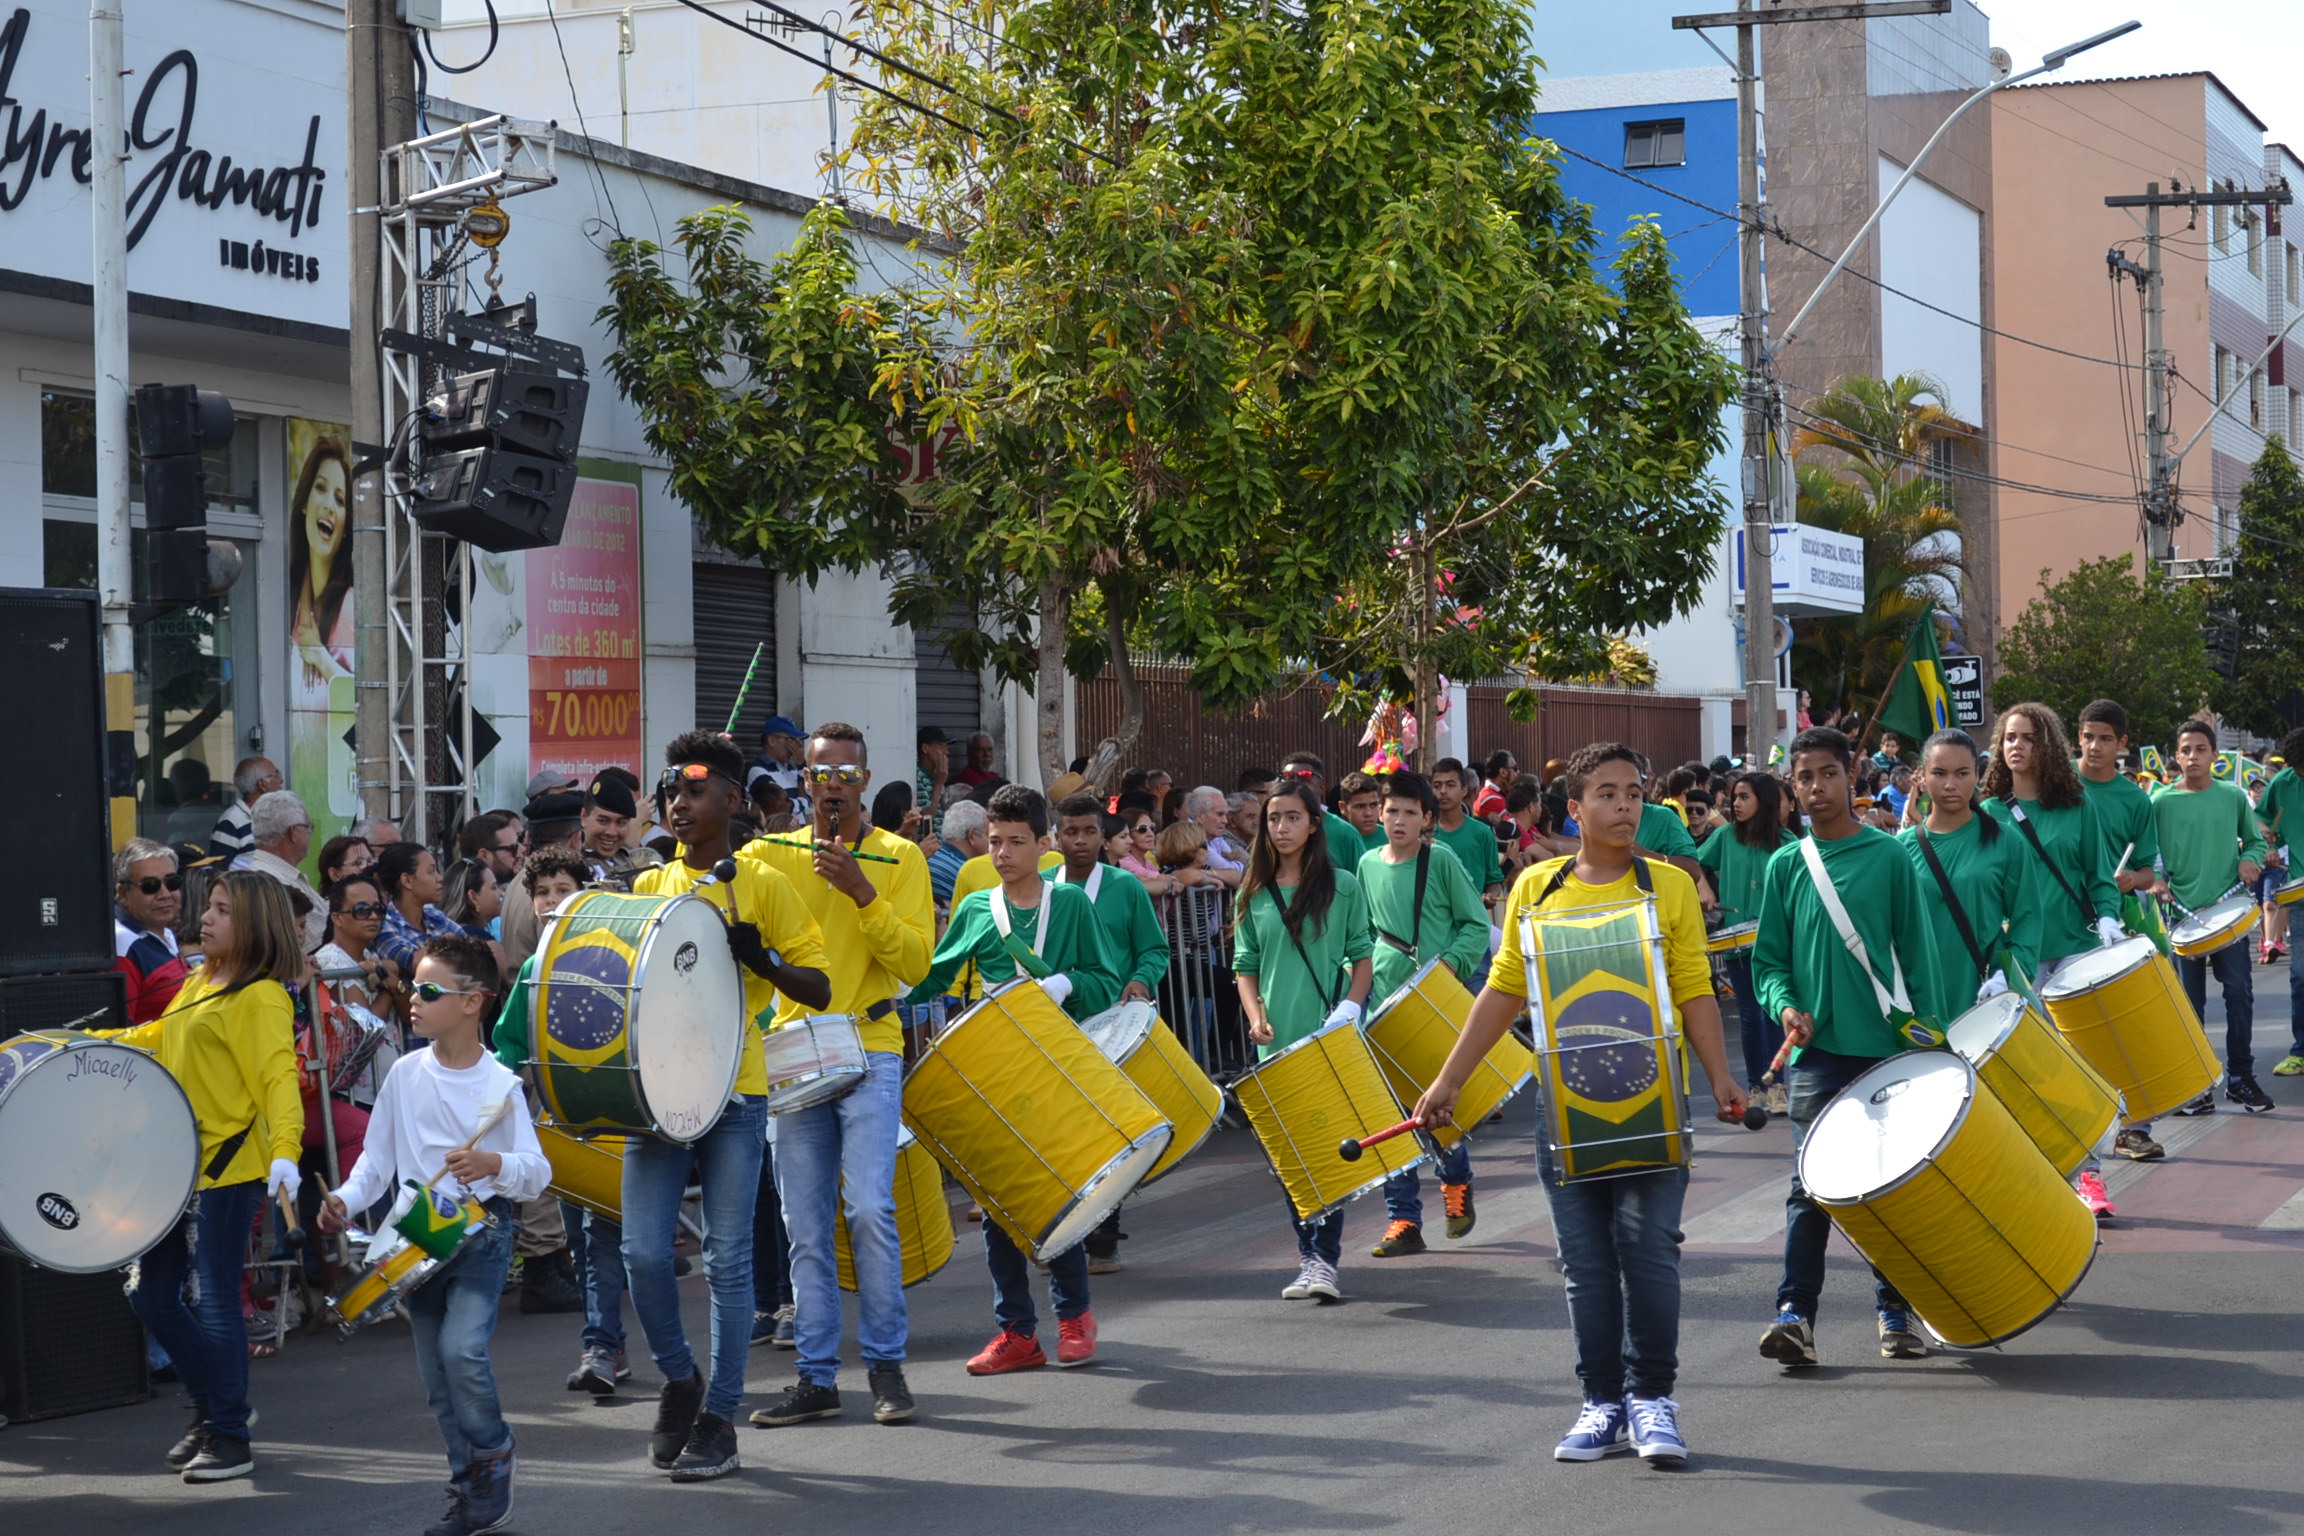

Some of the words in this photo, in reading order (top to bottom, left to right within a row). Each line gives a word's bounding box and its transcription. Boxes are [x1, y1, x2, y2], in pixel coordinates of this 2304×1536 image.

[593, 530, 604, 550] DE
[606, 532, 626, 552] 2012
[560, 571, 566, 589] 5
[567, 573, 603, 592] minutos
[605, 574, 617, 593] do
[548, 597, 576, 614] centro
[579, 596, 589, 615] da
[591, 598, 620, 617] cidade
[535, 626, 571, 656] Lotes
[575, 626, 590, 657] de
[594, 629, 618, 658] 360
[565, 668, 571, 686] a
[572, 666, 595, 688] partir
[596, 666, 608, 686] de
[1962, 689, 1981, 699] ESTÁ
[533, 708, 544, 726] R$
[677, 947, 696, 970] BNB
[67, 1050, 138, 1091] Micaelly
[41, 1197, 76, 1227] BNB
